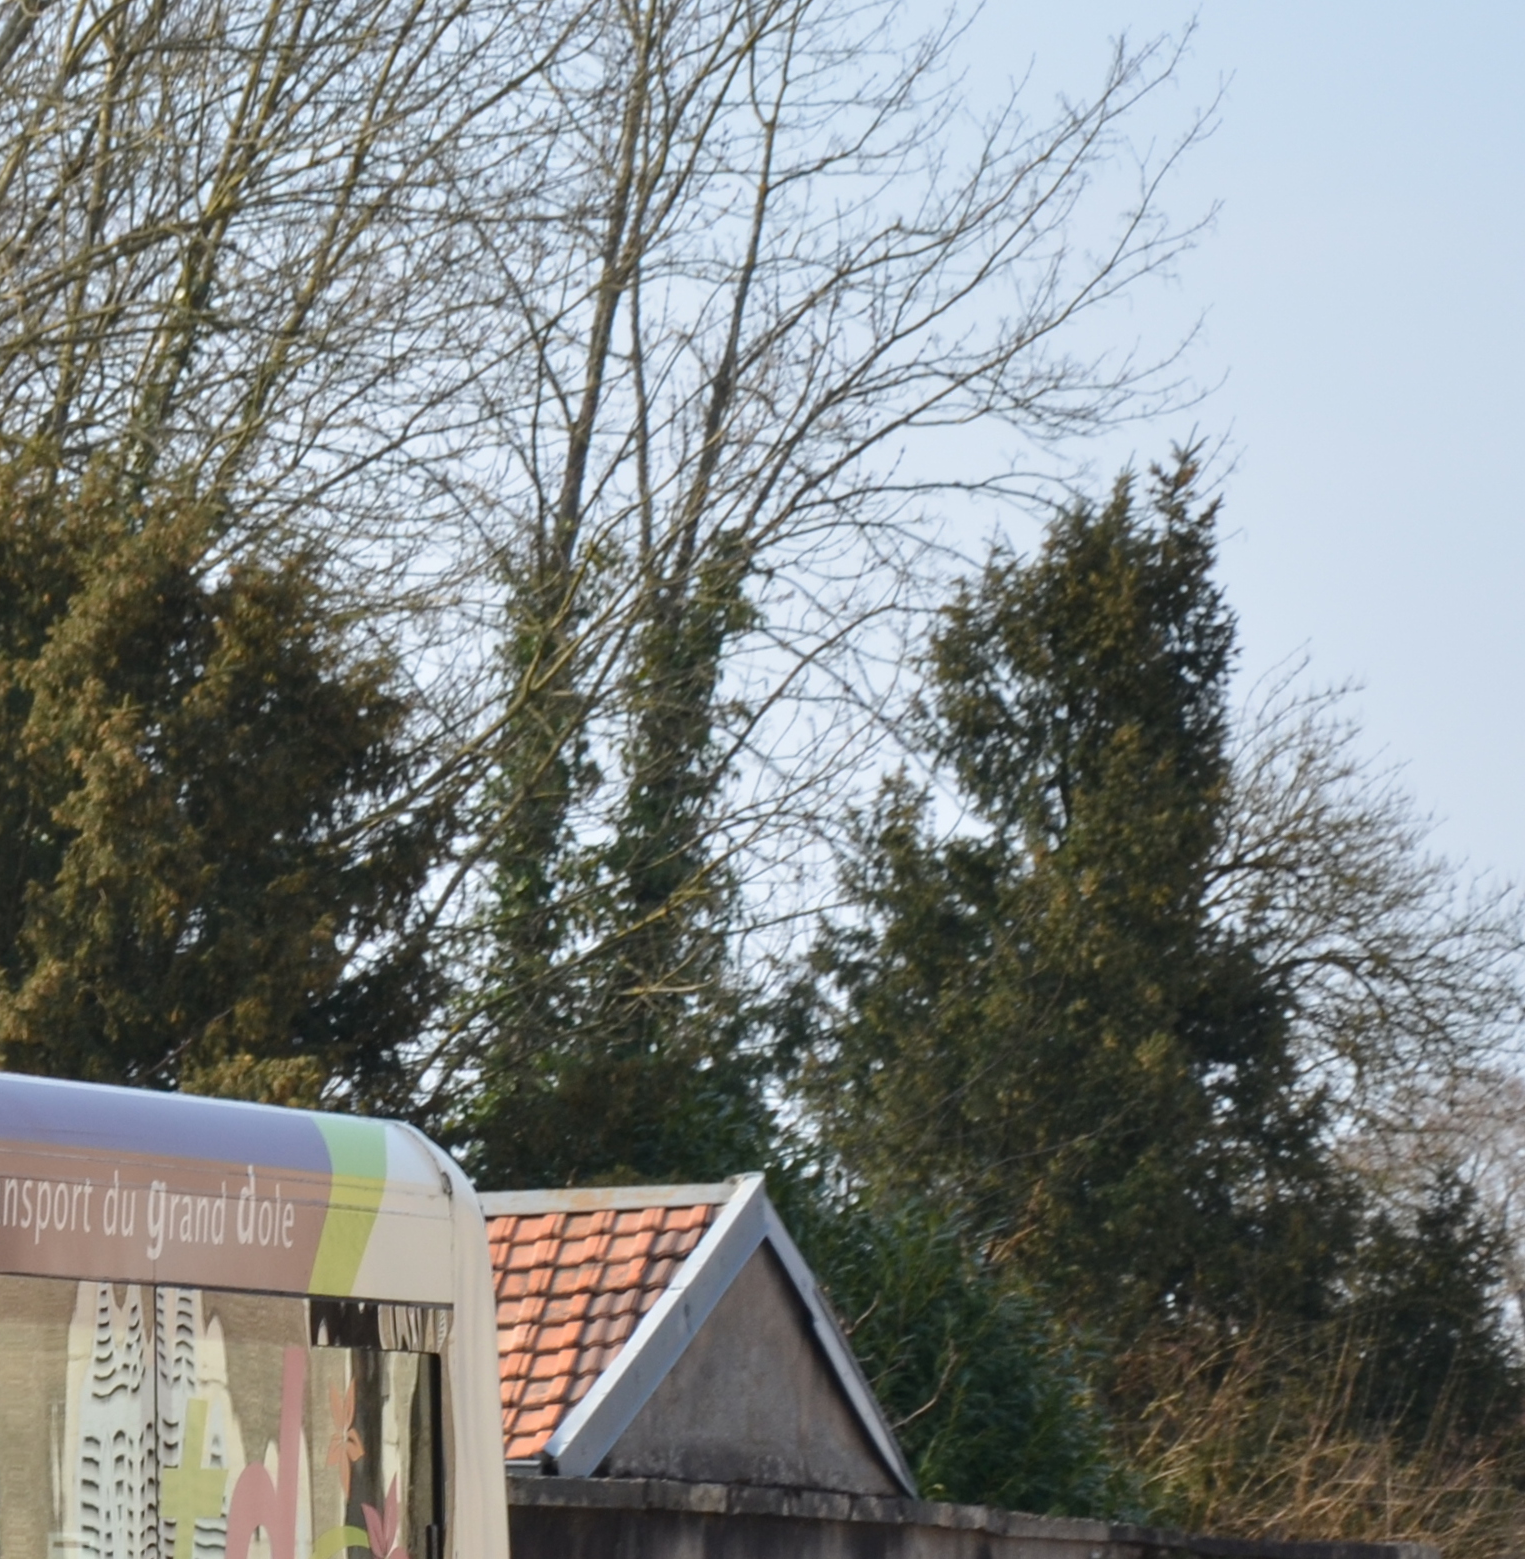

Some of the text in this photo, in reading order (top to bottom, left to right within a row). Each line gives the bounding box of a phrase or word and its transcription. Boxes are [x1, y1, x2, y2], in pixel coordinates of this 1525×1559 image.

[102, 1169, 136, 1238] du
[146, 1178, 227, 1260] grand
[237, 1164, 295, 1249] dole
